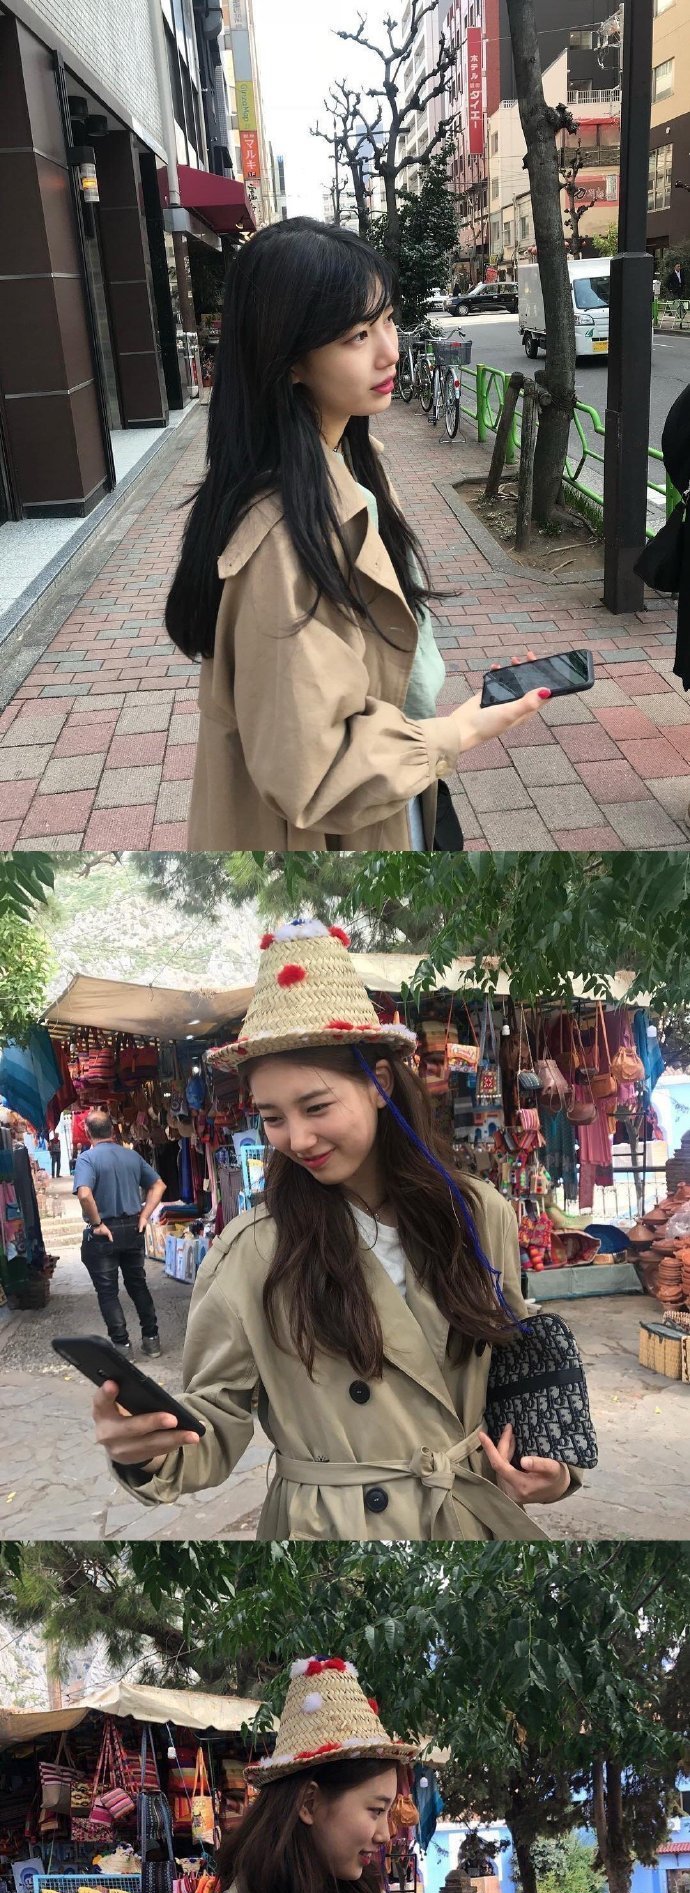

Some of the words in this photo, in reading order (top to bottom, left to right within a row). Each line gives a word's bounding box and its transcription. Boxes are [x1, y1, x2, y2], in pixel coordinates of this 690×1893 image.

[470, 55, 479, 80] ホテル
[470, 90, 481, 128] ダイエー
[244, 139, 256, 170] マルキ
